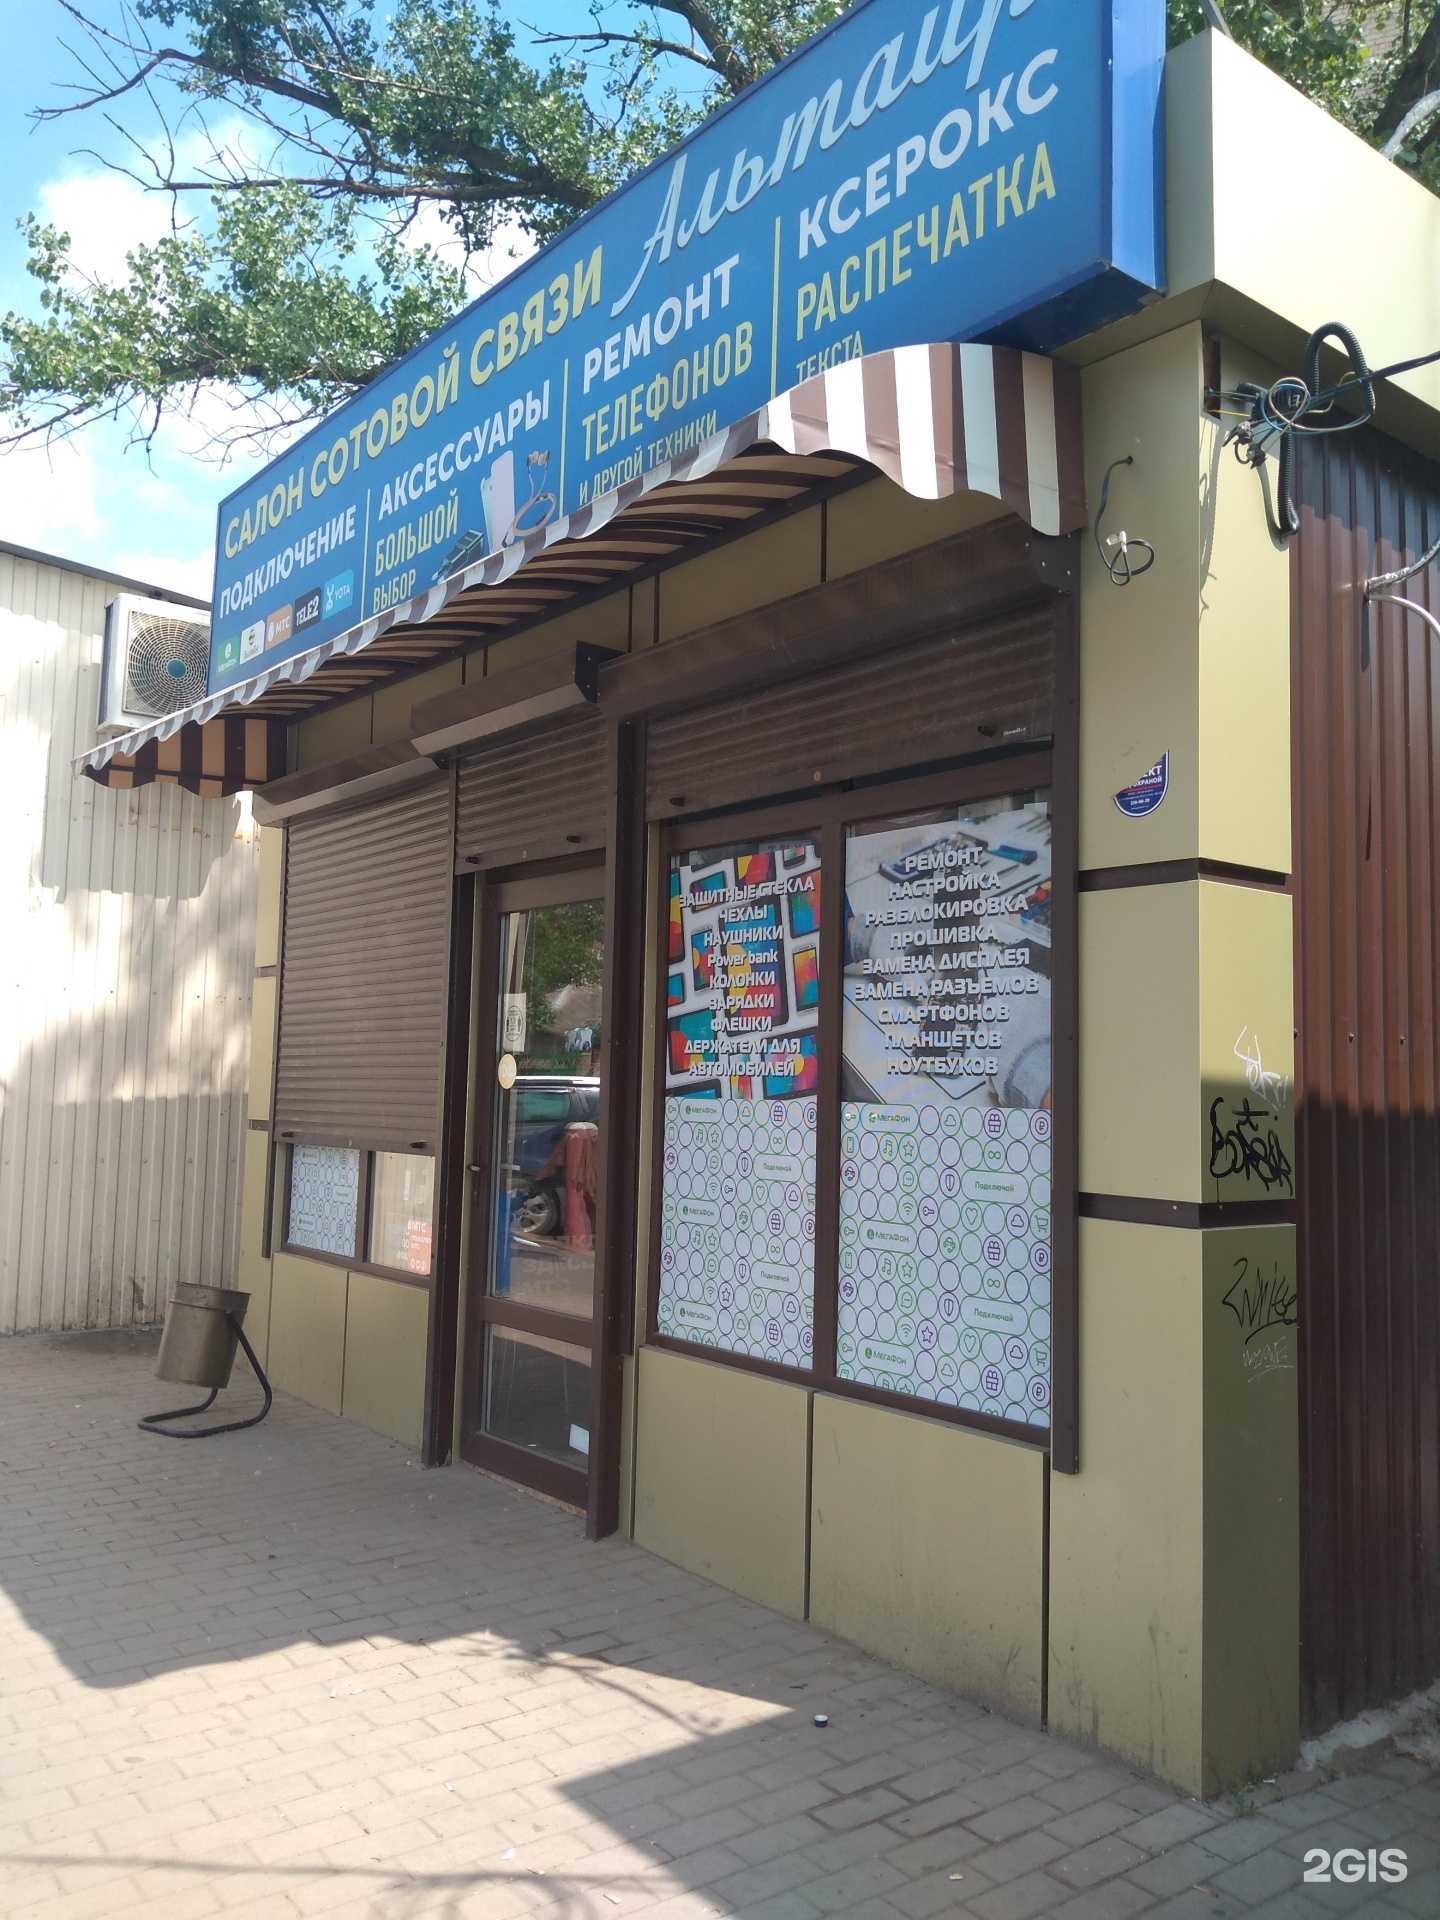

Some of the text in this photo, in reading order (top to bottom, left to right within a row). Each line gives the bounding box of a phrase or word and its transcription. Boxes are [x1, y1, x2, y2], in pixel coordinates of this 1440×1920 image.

[798, 48, 1059, 259] КСЕРОКС
[796, 142, 1056, 341] РАСПЕЧАТКА
[582, 254, 740, 393] РЕМОНТ
[796, 330, 863, 385] ТЕКСТА
[224, 245, 603, 558] САЛОН СОТОВОЙ СВЯЗИ
[582, 320, 754, 461] ТЕЛЕФОНОВ
[378, 380, 550, 521] АКСЕССУАРЫ
[579, 408, 718, 505] И ДРУГОЙ ТЕХНИКИ
[375, 488, 459, 577] БОЛЬШОЙ
[219, 504, 357, 619] ПОДКЛЮЧЕНИЕ
[373, 568, 416, 614] ВЫБОР
[296, 594, 320, 627] TELE2
[275, 615, 291, 635] МТС
[904, 846, 984, 873] РЕМОНТ
[679, 882, 756, 908] ЗАЩИТНЫЕ
[888, 871, 1001, 901] НАСТРОЙКА
[719, 904, 768, 924] ЧЕХЛЫ
[865, 894, 1030, 928] РАЗБЛОКИРОВКА
[703, 925, 784, 948] НАУШНИКИ
[889, 925, 998, 950] ПРОШИВКА
[707, 949, 778, 969] Power bank
[862, 947, 1031, 976] ЗАМЕНА ДИСПЛЕЯ
[709, 971, 776, 991] КОЛОНКИ
[855, 975, 1041, 1001] ЗАМЕНА РАЗЪЕМОВ
[708, 993, 776, 1012] ЗАРЯДКИ
[878, 1004, 1011, 1024] СМАРТФОНОВ
[710, 1015, 773, 1033] ФЛЕШКИ
[683, 1039, 801, 1056] ДЕРЖАТЕЛИ ДЛЯ
[884, 1030, 1003, 1050] ПЛАНШЕТОВ
[688, 1058, 797, 1078] АВТОМОБИЛЕЙ
[886, 1056, 1001, 1076] НОУТБУКОВ
